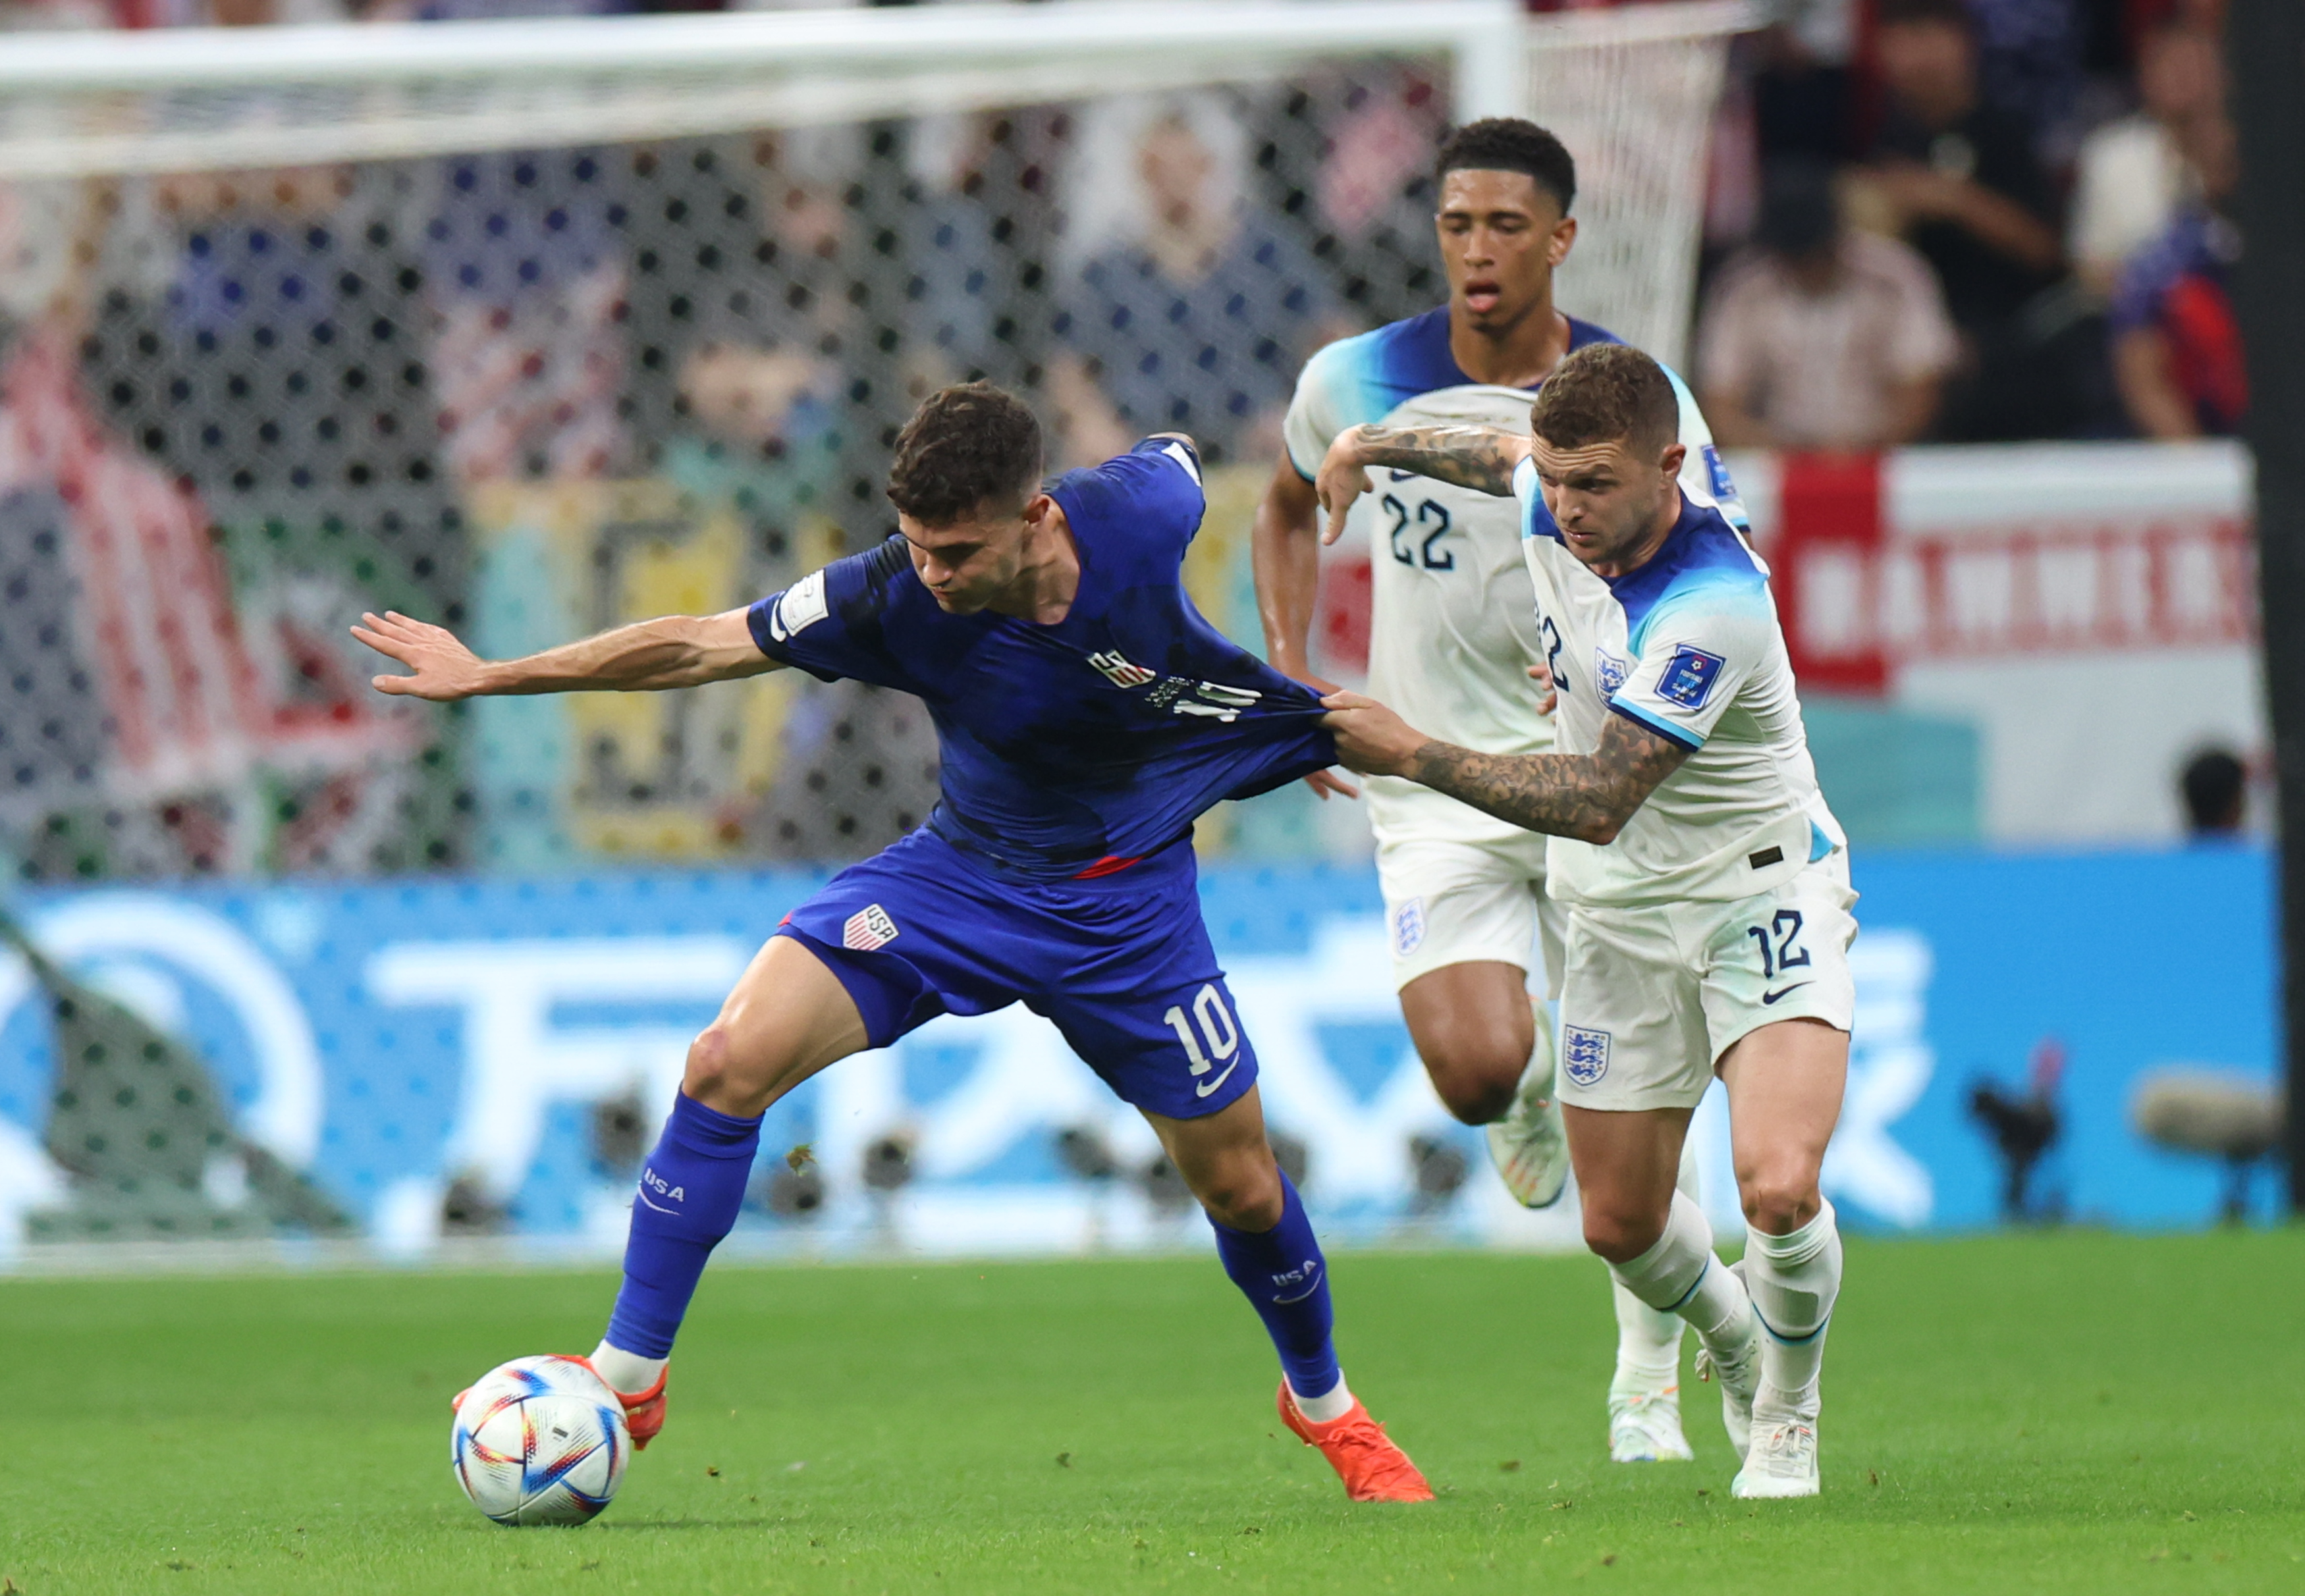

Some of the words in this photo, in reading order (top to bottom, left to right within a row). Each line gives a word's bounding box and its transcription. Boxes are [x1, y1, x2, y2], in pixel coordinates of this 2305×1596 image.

[1382, 494, 1453, 570] 22
[1535, 602, 1570, 693] 2
[866, 907, 895, 940] USA
[1747, 909, 1811, 980] 12
[1164, 982, 1238, 1077] 10
[644, 1167, 684, 1203] USA
[1271, 1260, 1317, 1287] USA
